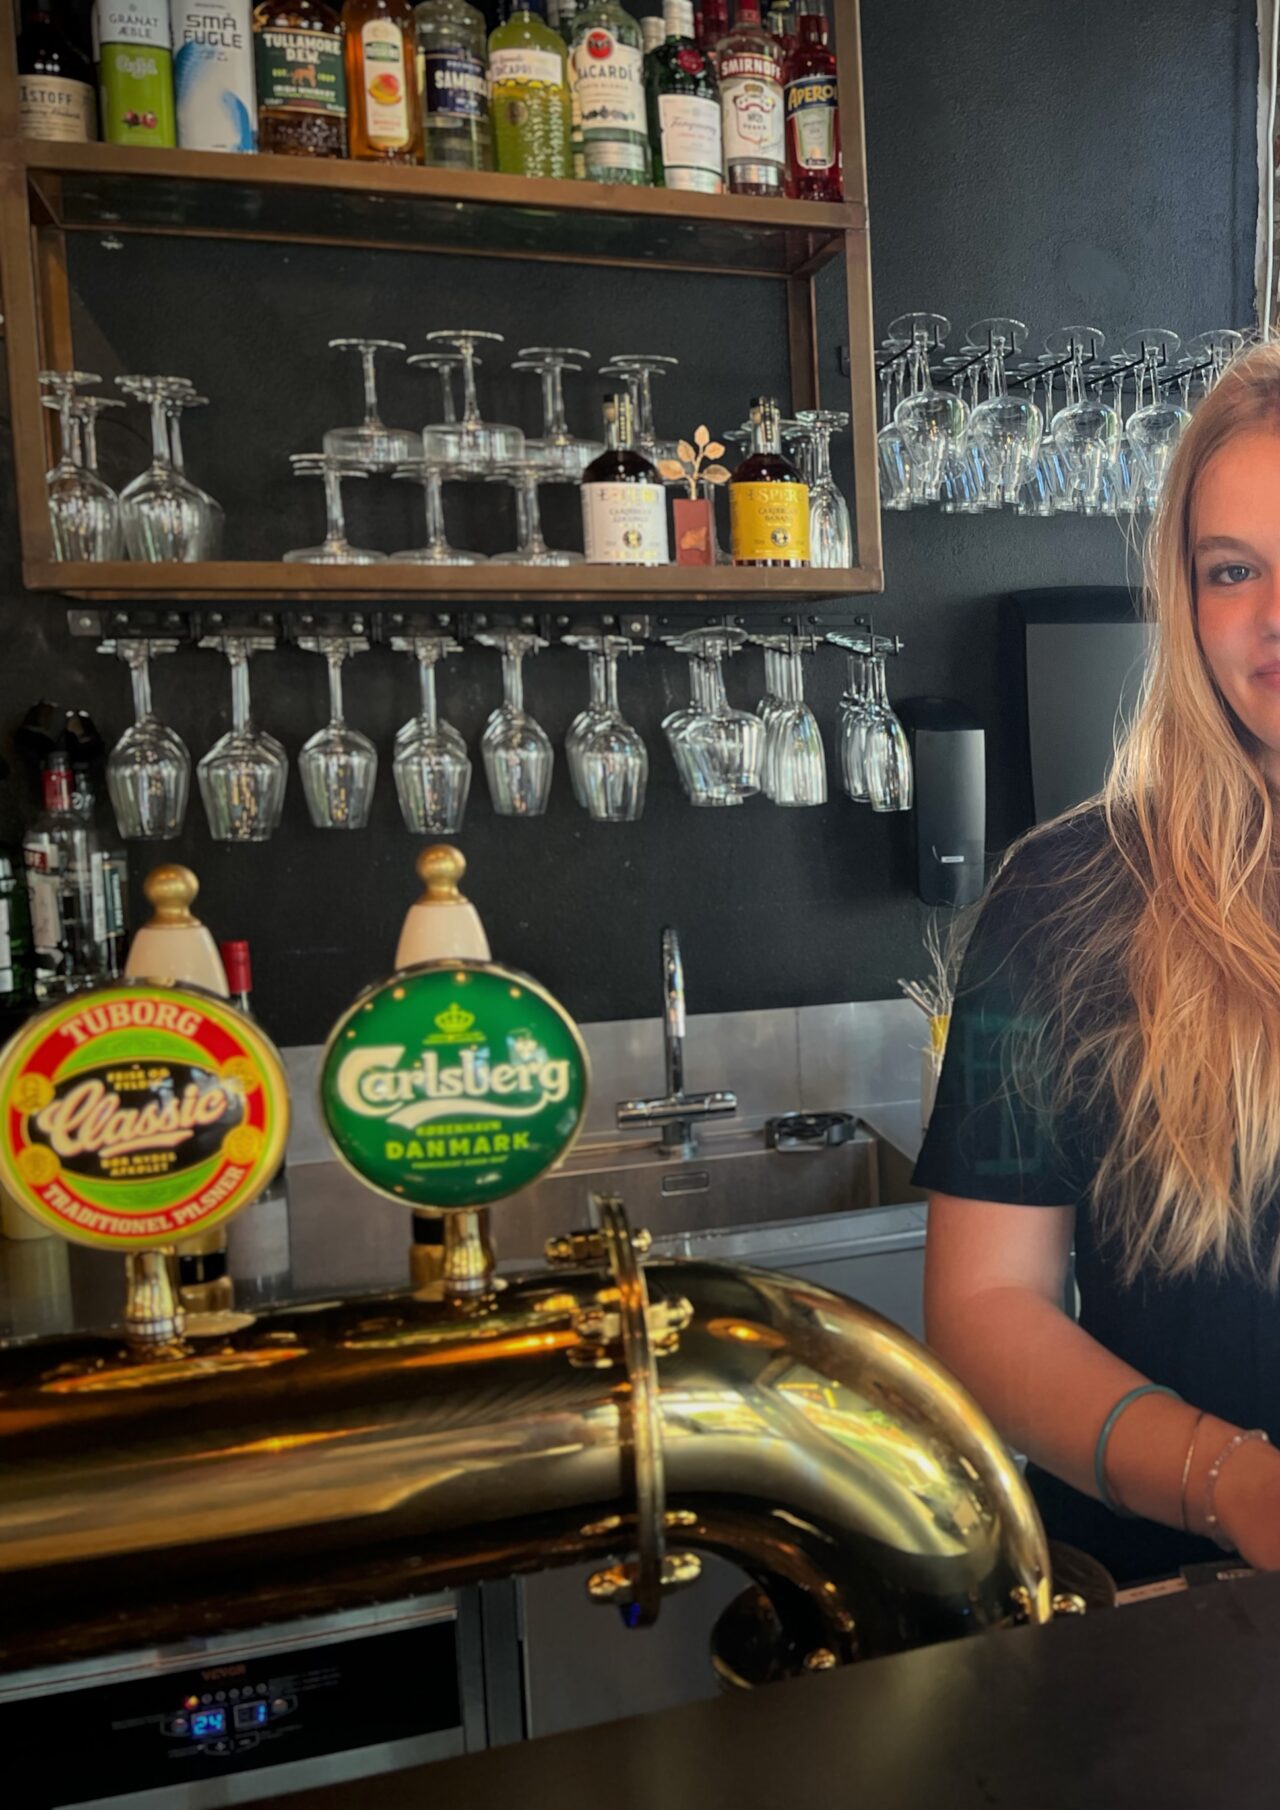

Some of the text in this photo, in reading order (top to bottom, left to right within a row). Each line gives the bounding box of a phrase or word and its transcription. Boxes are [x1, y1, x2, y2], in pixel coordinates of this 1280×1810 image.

[186, 13, 237, 31] SMÅ
[183, 29, 243, 49] FUGLE
[262, 33, 341, 56] TULLAMORE
[60, 1001, 203, 1045] TUBORG
[337, 1044, 570, 1118] Carlsberg
[36, 1079, 230, 1156] Classic
[385, 1131, 530, 1160] DANMARK
[42, 1166, 246, 1235] TRADITIONEL PILSNER
[193, 1713, 223, 1736] 24
